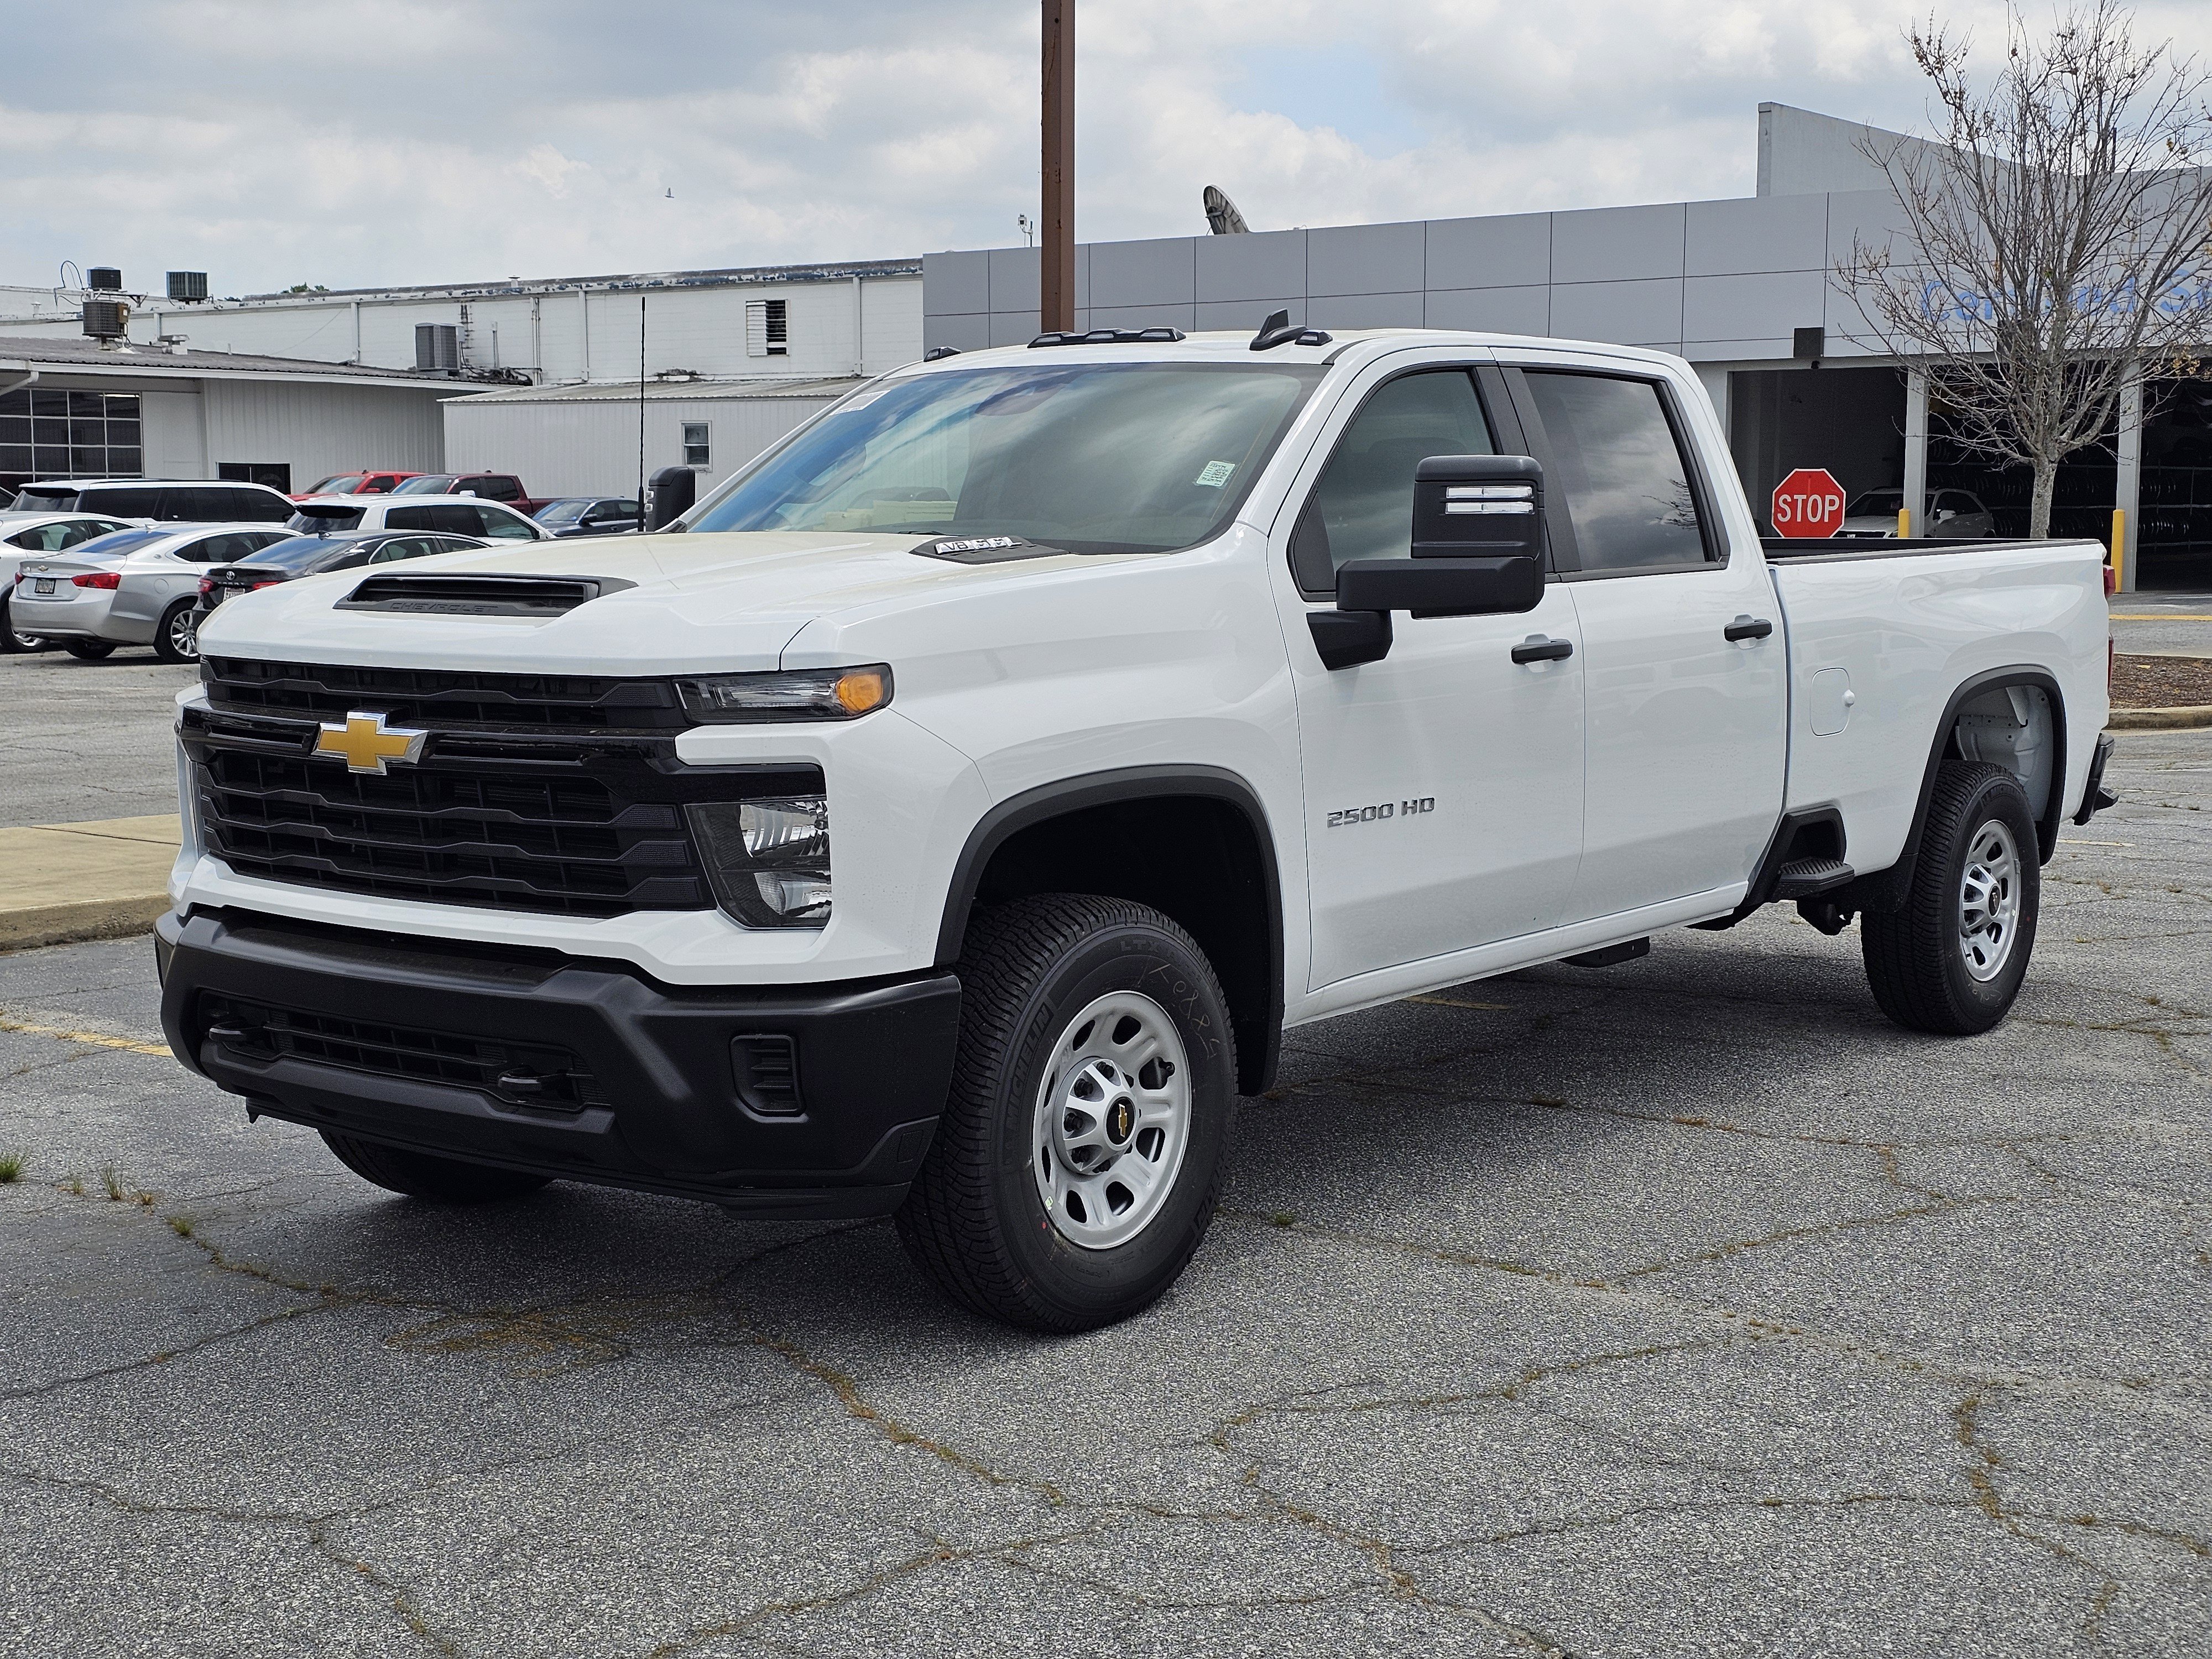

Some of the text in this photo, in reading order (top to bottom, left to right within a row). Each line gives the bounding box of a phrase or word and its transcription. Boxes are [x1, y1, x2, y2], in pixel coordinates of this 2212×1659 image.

[1777, 494, 1840, 523] STOP
[941, 541, 970, 551] V8
[390, 602, 499, 612] CHEVROLET
[1327, 797, 1435, 828] 2500 HD
[1006, 1003, 1050, 1130] MICHELIN
